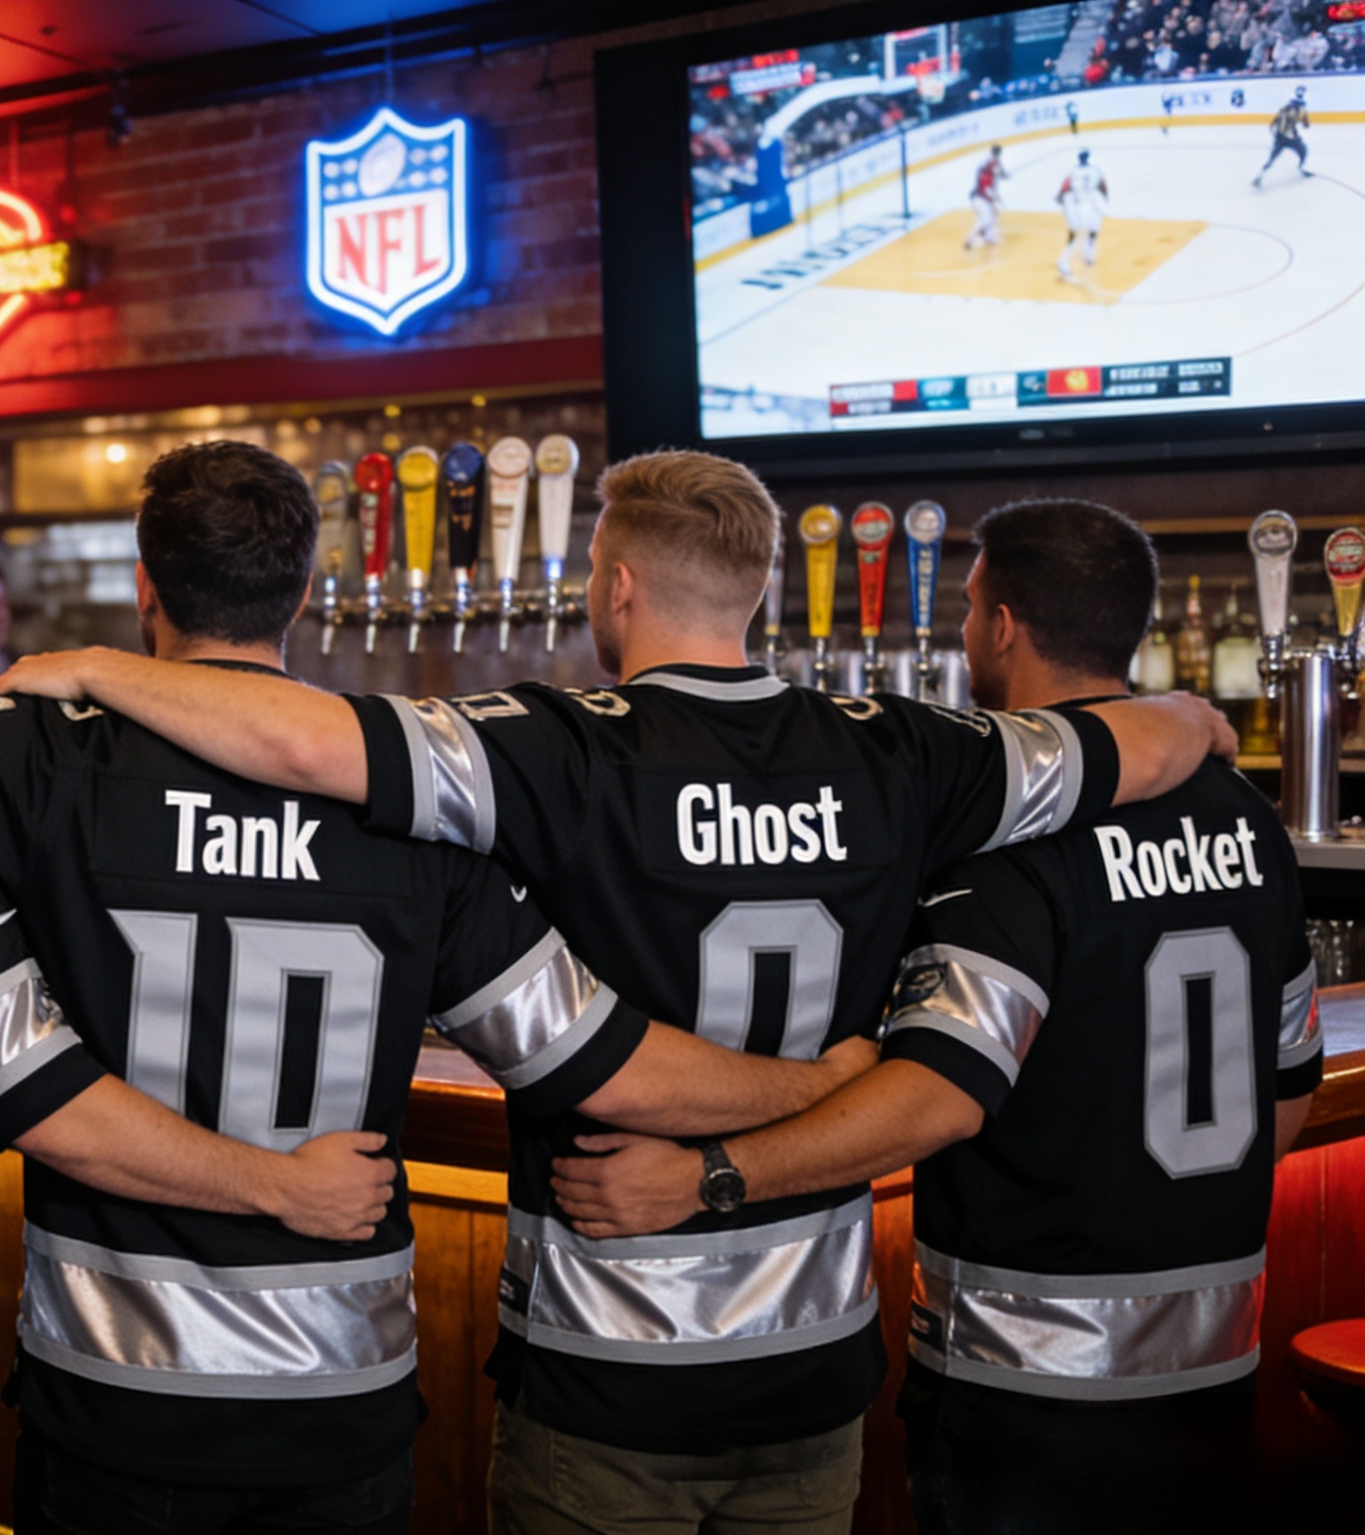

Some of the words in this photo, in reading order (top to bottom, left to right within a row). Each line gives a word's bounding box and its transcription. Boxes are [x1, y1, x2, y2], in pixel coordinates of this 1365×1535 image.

[335, 203, 444, 296] NFL
[165, 789, 321, 881] Tank
[676, 783, 848, 866] Ghost
[1094, 816, 1264, 902] Rocket
[695, 898, 844, 1062] 0
[106, 908, 386, 1155] 10
[1144, 925, 1258, 1181] 0
